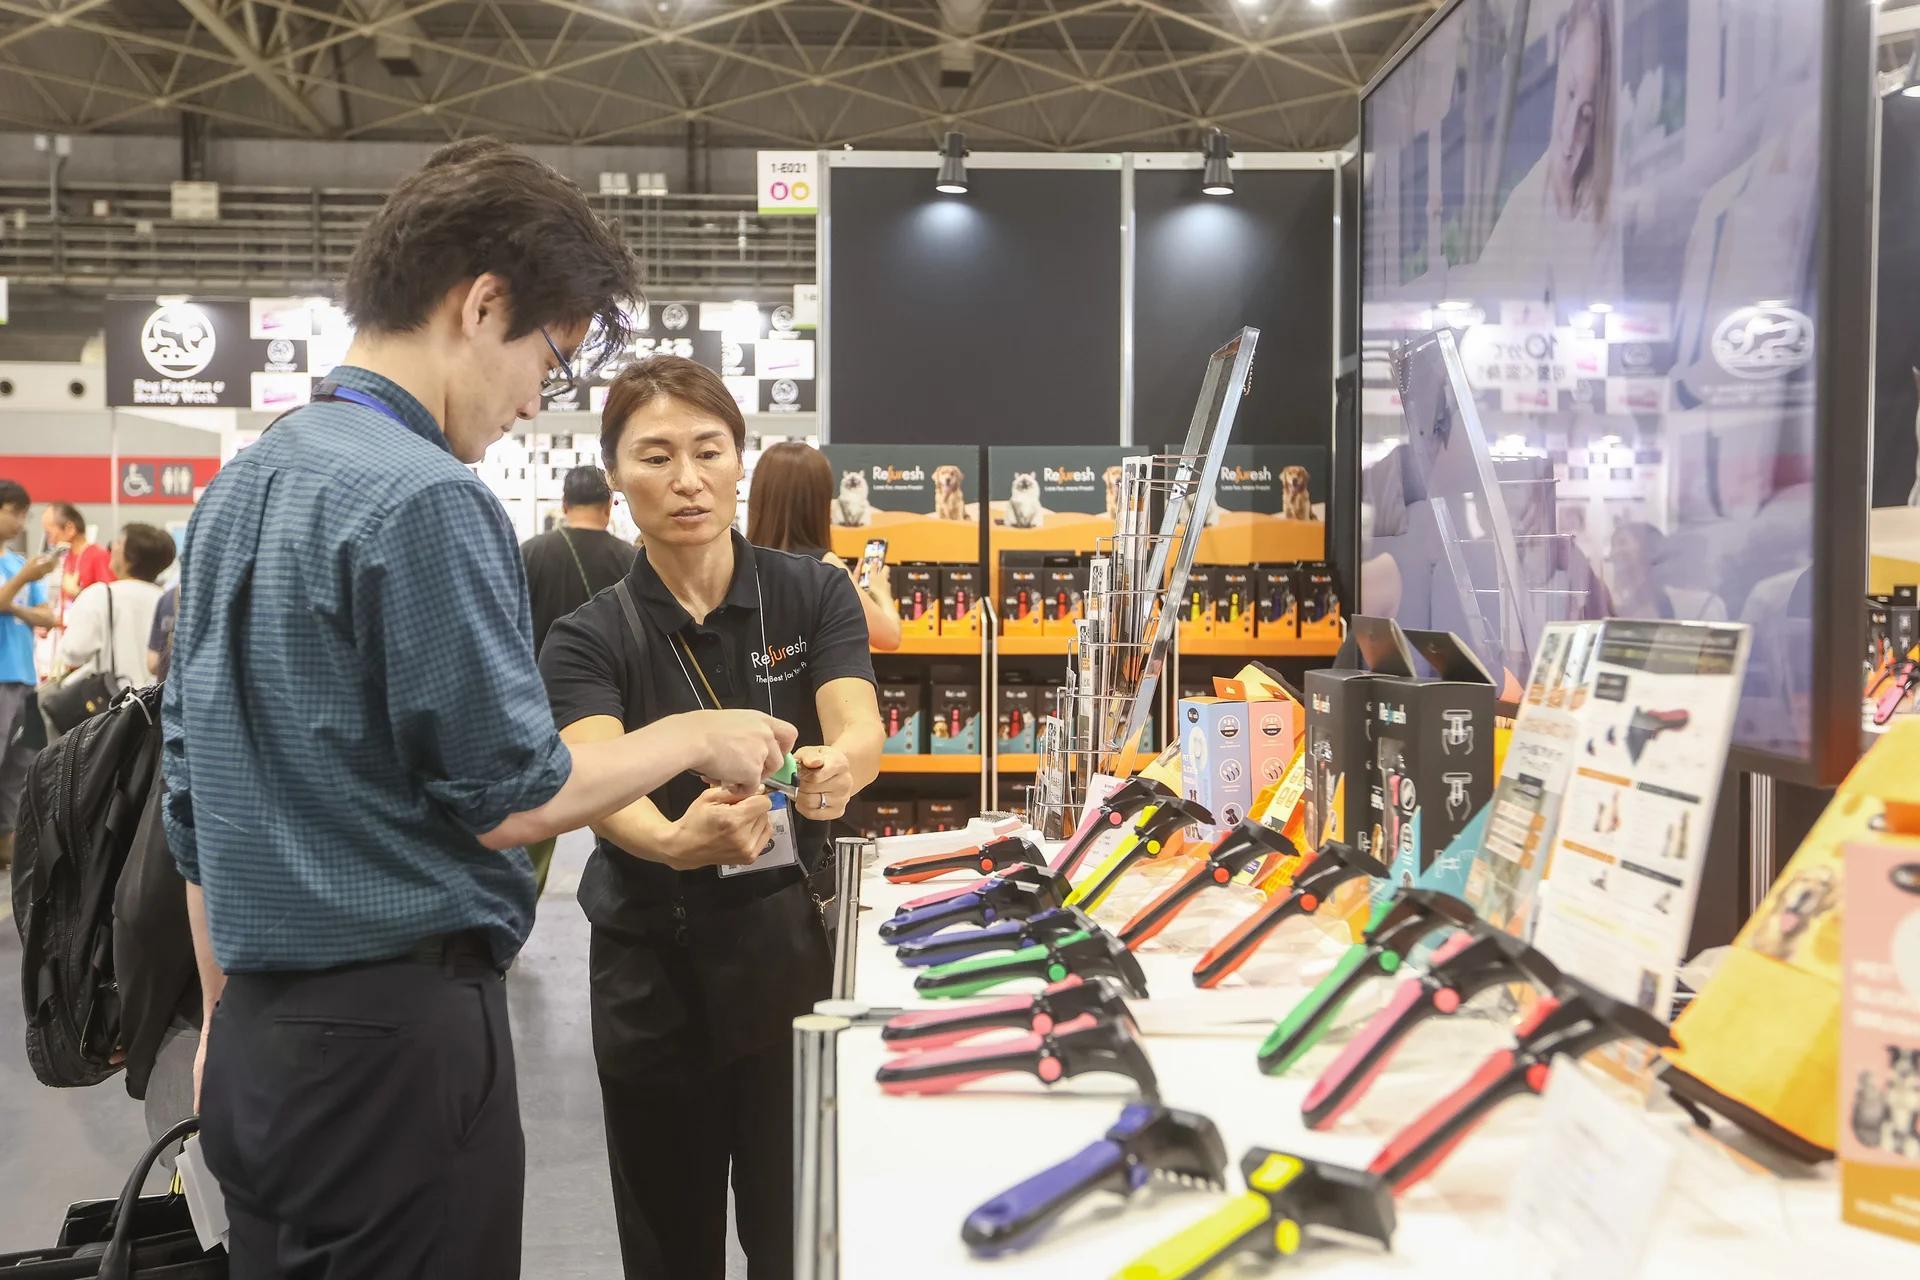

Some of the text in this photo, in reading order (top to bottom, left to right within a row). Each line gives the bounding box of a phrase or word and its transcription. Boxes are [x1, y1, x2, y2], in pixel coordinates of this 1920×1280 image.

[771, 162, 808, 174] 1-E021
[872, 464, 925, 484] Refuresh
[1043, 466, 1095, 485] Refuresh
[1220, 464, 1272, 484] Refuresh
[750, 634, 807, 668] Refuresh
[755, 674, 768, 683] The
[769, 674, 784, 683] Best
[784, 671, 795, 681] for
